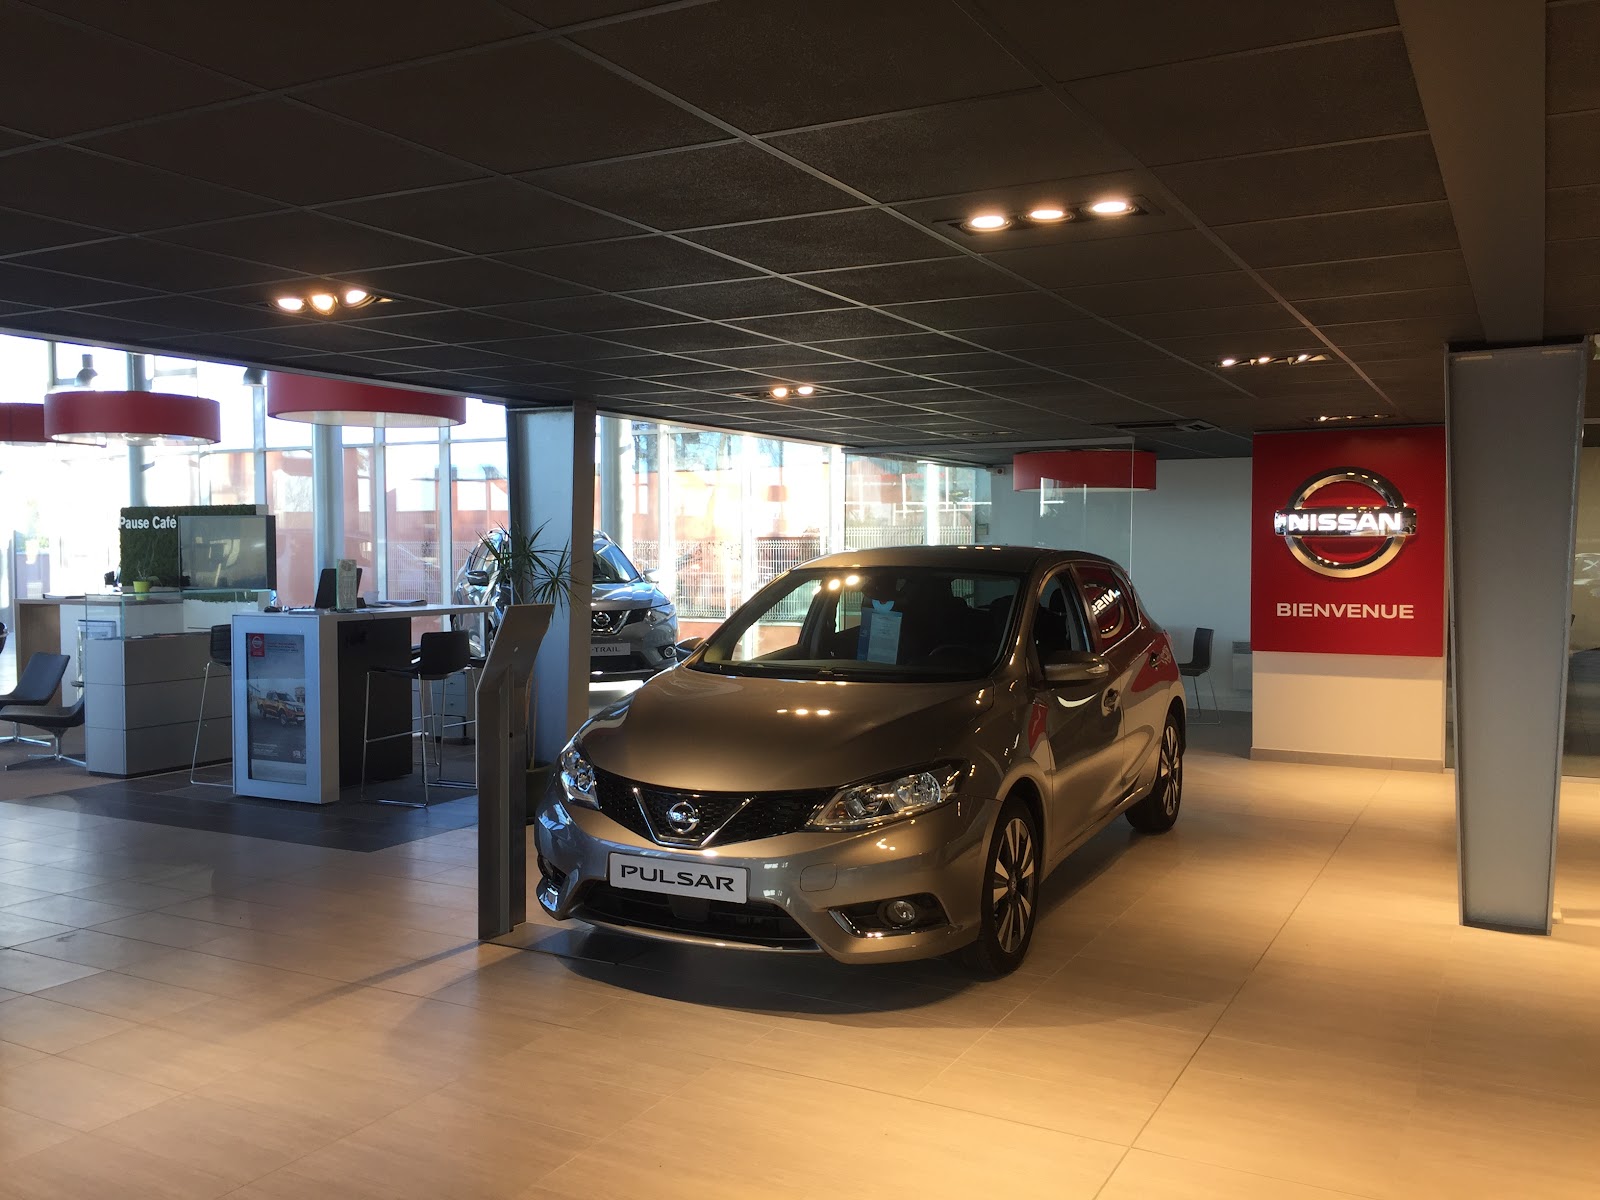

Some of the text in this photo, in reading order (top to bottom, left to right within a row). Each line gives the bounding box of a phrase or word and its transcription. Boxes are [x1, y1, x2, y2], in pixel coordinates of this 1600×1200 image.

[119, 514, 177, 529] Pause Café
[1288, 513, 1403, 531] NISSAN
[1276, 602, 1415, 620] BIENVENUE
[620, 864, 735, 892] PULSAR
